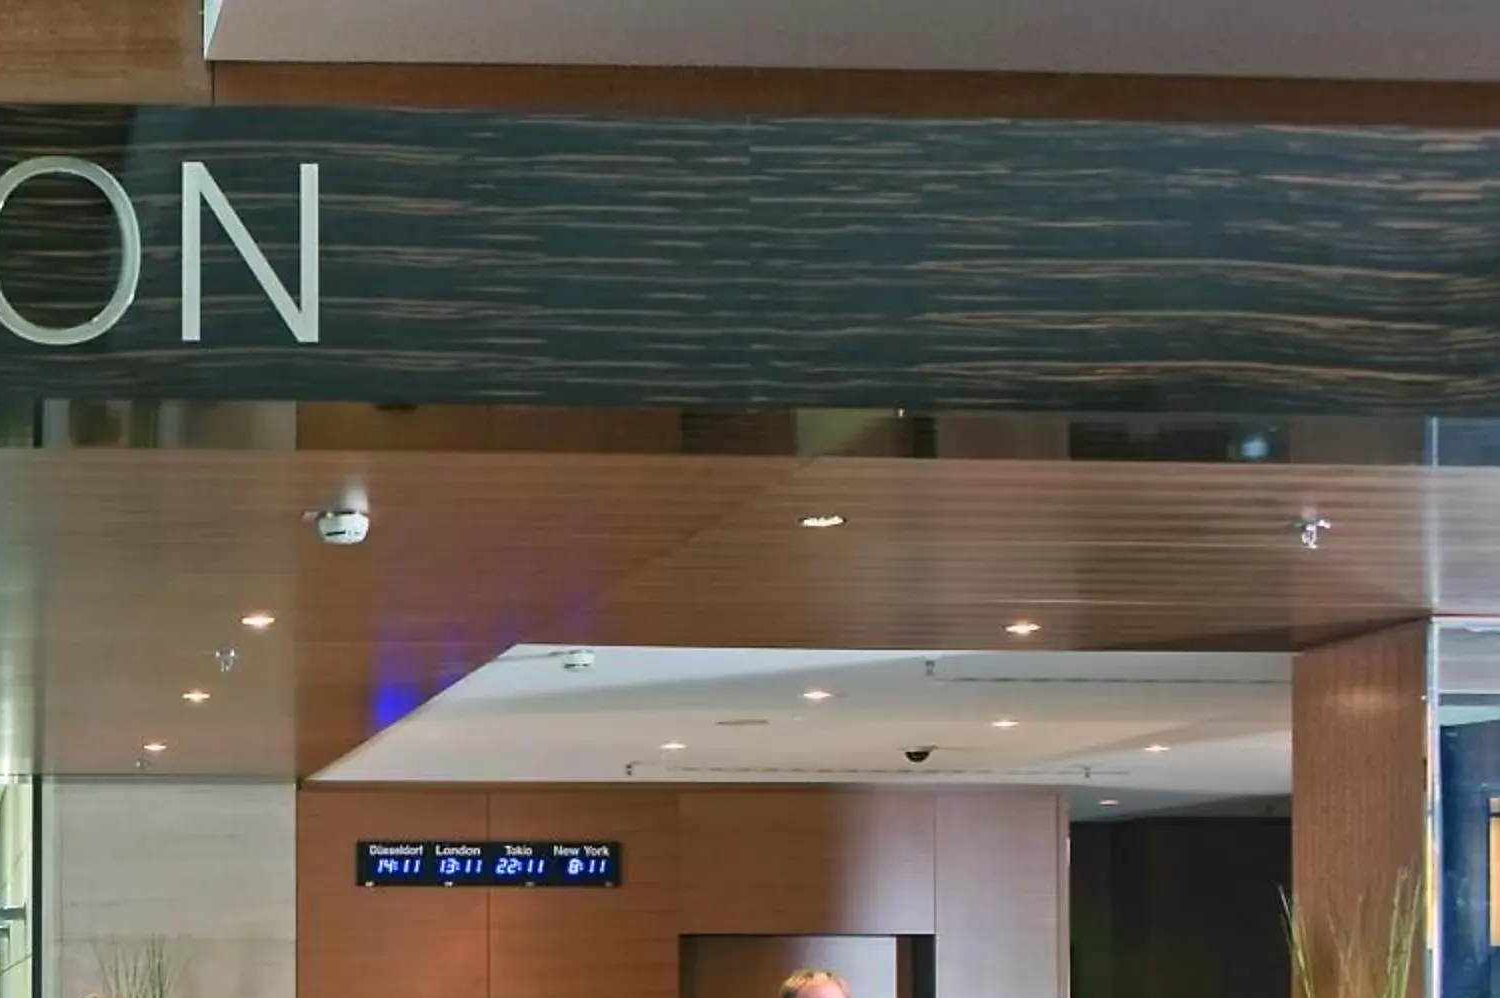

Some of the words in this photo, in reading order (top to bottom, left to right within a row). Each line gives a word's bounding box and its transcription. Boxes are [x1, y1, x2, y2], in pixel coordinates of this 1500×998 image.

[435, 844, 481, 856] London
[504, 844, 533, 856] Tokio
[553, 844, 580, 856] New
[583, 844, 610, 856] York
[377, 859, 421, 874] 14:11
[439, 858, 483, 874] 13:11
[495, 858, 545, 875] 22:11
